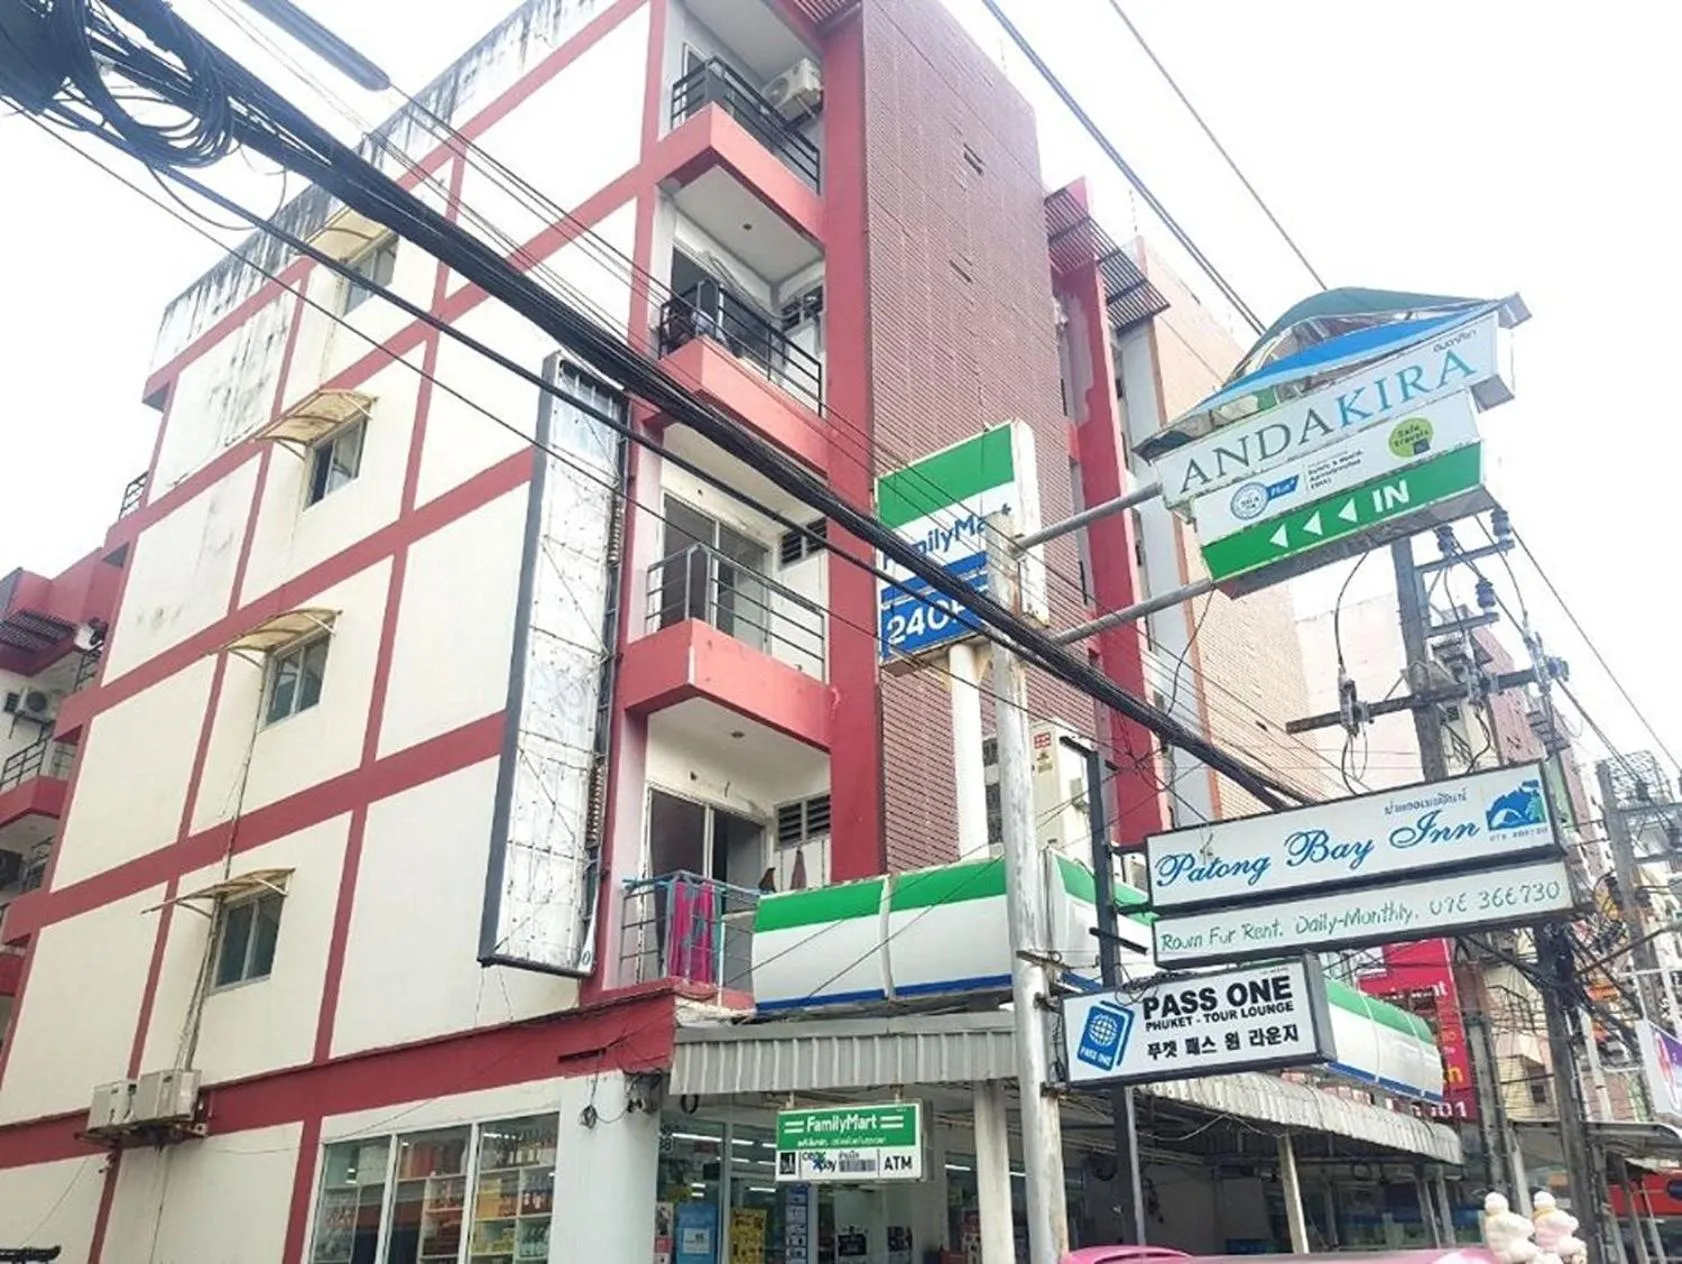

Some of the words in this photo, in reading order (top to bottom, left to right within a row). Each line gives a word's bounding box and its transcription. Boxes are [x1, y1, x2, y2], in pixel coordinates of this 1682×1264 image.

[1181, 348, 1477, 493] ANDAKIRA
[1374, 481, 1409, 512] IN
[1155, 853, 1270, 887] Patong
[1284, 830, 1374, 870] Bay
[1389, 809, 1481, 849] Inn
[1143, 987, 1218, 1020] PASS
[1227, 976, 1292, 1007] ONE
[1145, 1016, 1193, 1032] PHUKET
[1203, 1011, 1238, 1024] TOUR
[1241, 1001, 1294, 1018] LOUNGE
[1224, 1031, 1240, 1050] 원
[1249, 1024, 1299, 1046] 라운지
[807, 1113, 878, 1133] FamilyMart
[884, 1155, 912, 1171] ATM
